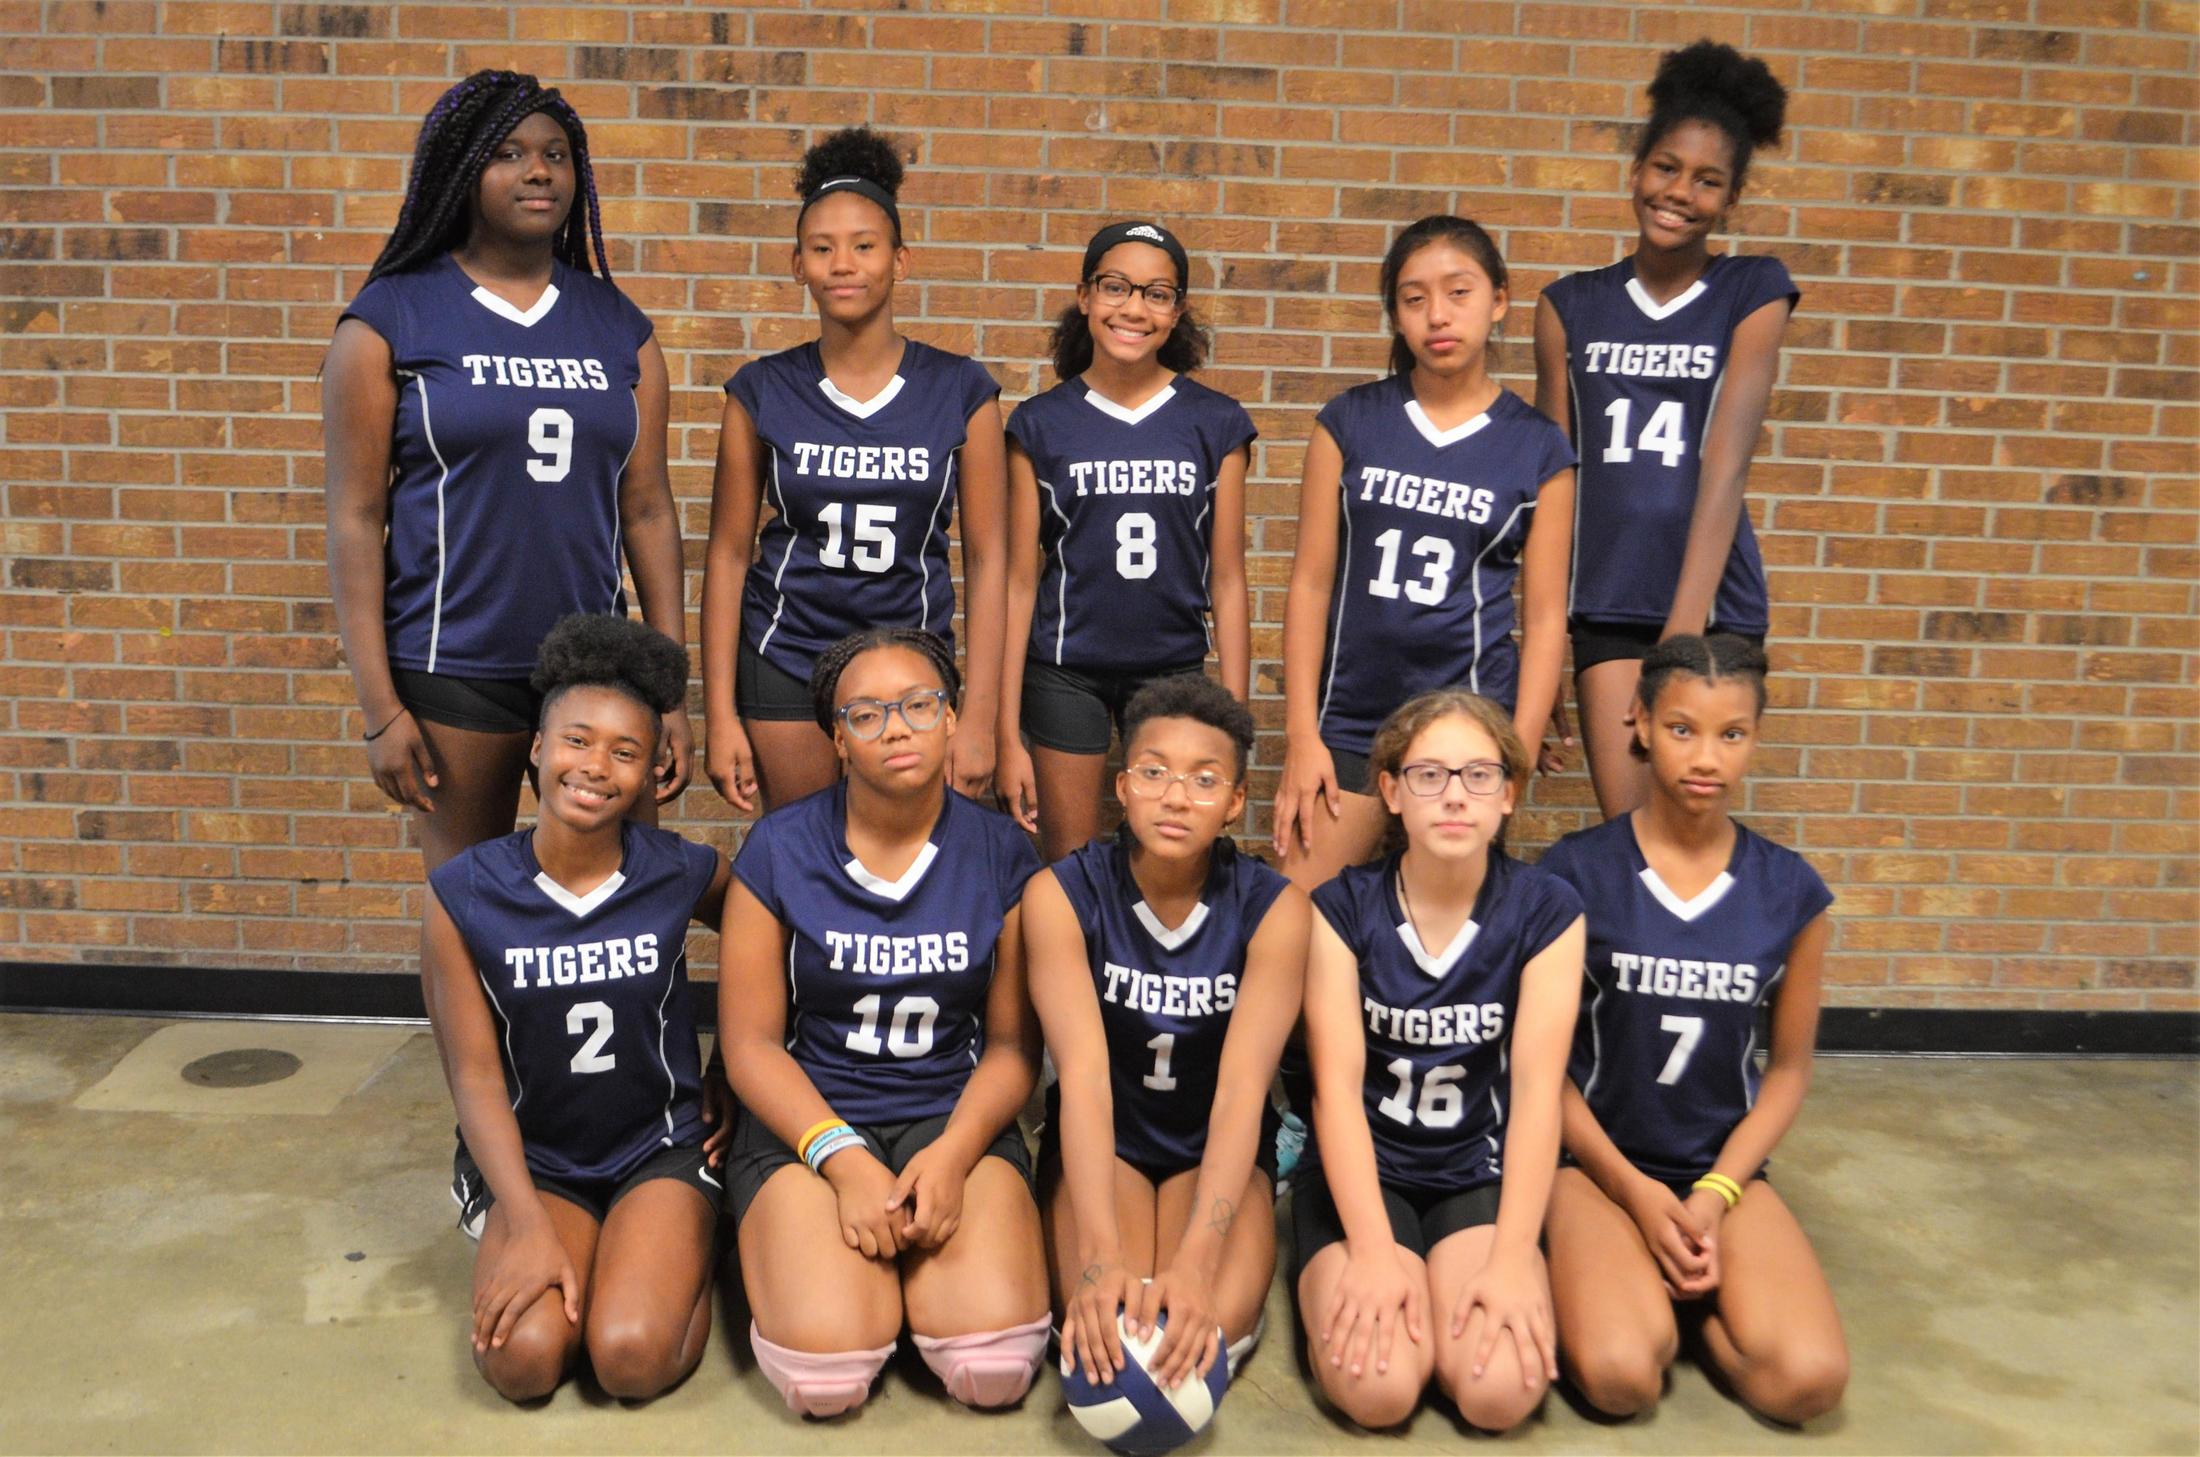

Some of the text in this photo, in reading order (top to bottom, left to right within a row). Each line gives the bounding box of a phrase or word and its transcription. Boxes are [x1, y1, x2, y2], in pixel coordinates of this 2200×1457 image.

[461, 354, 610, 391] TIGERS
[1584, 341, 1717, 380] TIGERS
[526, 407, 574, 483] 9
[793, 441, 930, 482] TIGERS
[1602, 397, 1687, 468] 14
[1068, 459, 1197, 497] TIGERS
[1359, 466, 1496, 525] TIGERS
[817, 502, 897, 573] 15
[1115, 512, 1158, 580] 8
[1368, 528, 1456, 607] 13
[504, 932, 659, 989] TIGERS
[825, 929, 969, 976] TIGERS
[1611, 951, 1759, 1003] TIGERS
[1103, 961, 1238, 1017] TIGERS
[565, 1000, 616, 1074] 2
[845, 994, 940, 1058] 10
[1363, 996, 1506, 1047] TIGERS
[1656, 1014, 1705, 1085] 7
[1143, 1032, 1176, 1090] 1
[1378, 1057, 1466, 1128] 16
